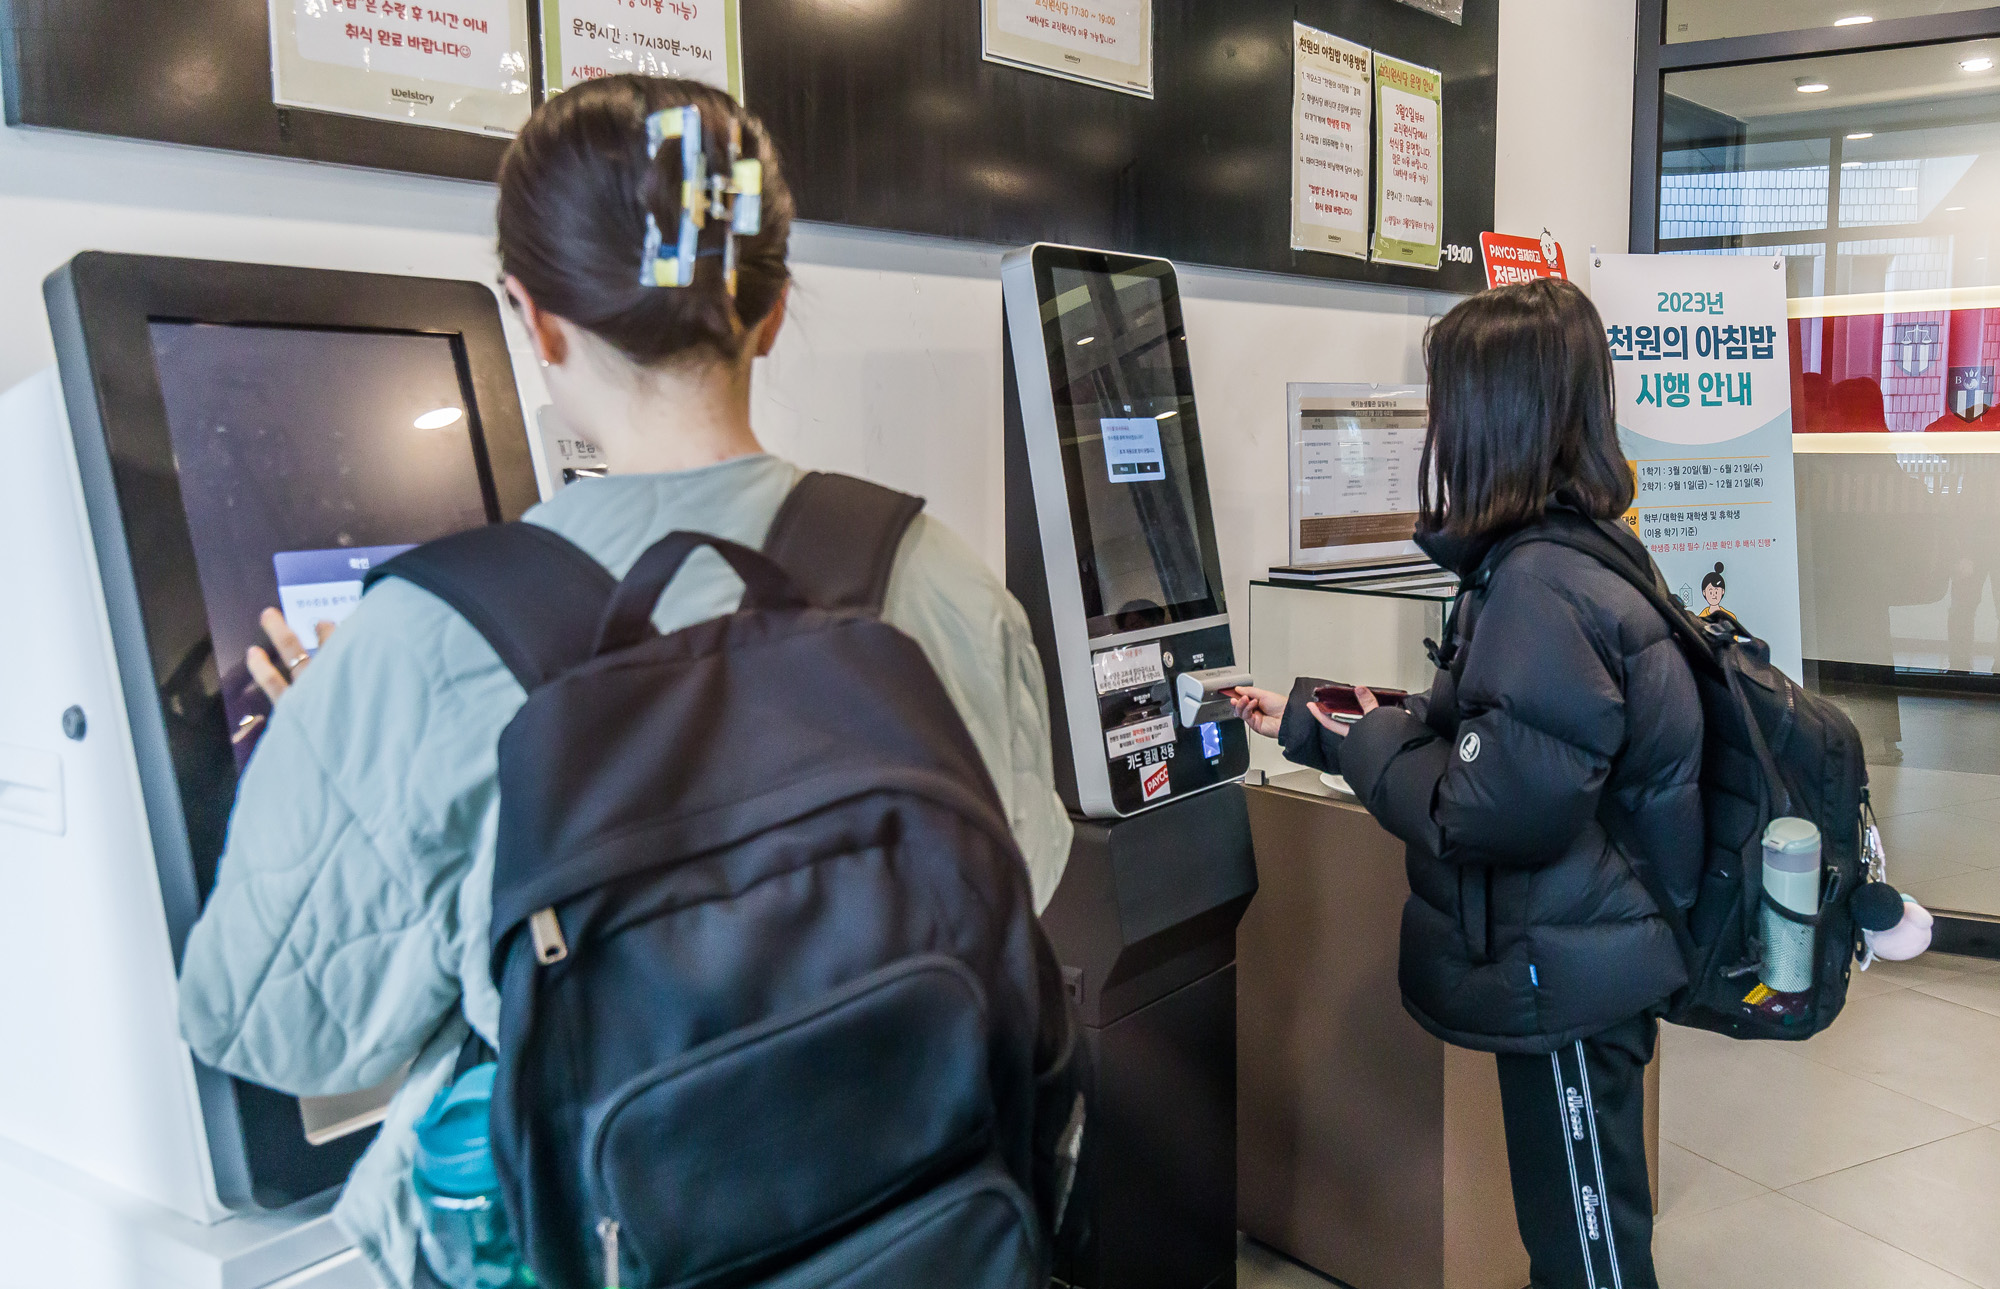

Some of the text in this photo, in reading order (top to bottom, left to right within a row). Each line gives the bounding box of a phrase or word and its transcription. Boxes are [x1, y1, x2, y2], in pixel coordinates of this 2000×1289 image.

[382, 1, 407, 20] 수령
[412, 6, 422, 21] 후
[428, 10, 459, 29] 1시간
[463, 18, 488, 33] 이내
[669, 2, 697, 20] 가능)
[1071, 5, 1089, 18] 17:30
[1098, 13, 1116, 26] 19:00
[345, 24, 373, 43] 취식
[377, 30, 403, 48] 완료
[573, 18, 621, 44] 운영시간
[632, 32, 712, 61] 17시30분~19시
[1051, 21, 1077, 36] 교직원식당
[1078, 28, 1088, 39] 이용
[1300, 37, 1367, 72] 천원의 아침밥 이용방법
[1306, 72, 1322, 84] 키오스크
[1379, 64, 1434, 93] 교직원식당 운영 안내
[1307, 93, 1323, 107] 학생식당
[1395, 103, 1424, 123] 3월2일부터
[1401, 156, 1410, 168] 이용
[1408, 171, 1417, 183] 이용
[1418, 174, 1429, 185] 가능)
[1386, 189, 1402, 202] 운영시간
[1489, 245, 1541, 263] PAYCO 결제하고
[1657, 291, 1724, 315] 2023년
[1606, 324, 1777, 361] 천원의 아침밥
[1635, 371, 1752, 408] 시행 안내
[1642, 466, 1662, 476] 1학기
[1668, 465, 1681, 476] 3월
[1682, 464, 1712, 475] 20일(월)
[1720, 464, 1732, 474] 6월
[1733, 462, 1764, 474] 21일(수)
[1642, 481, 1663, 492] 2학기
[1668, 480, 1681, 491] 9월
[1683, 479, 1708, 490] 1일(금)
[1716, 479, 1733, 489] 12월
[1734, 477, 1764, 488] 21일(목)
[1644, 509, 1741, 524] 학부/대학원 재학생 및 휴학생
[1644, 526, 1698, 539] (이용 학기 기준)
[1650, 543, 1671, 553] 학생증
[1687, 541, 1701, 552] 필수
[1720, 539, 1733, 550] 확인
[1735, 539, 1741, 549] 후
[1742, 538, 1756, 548] 배식
[1757, 538, 1771, 548] 진행
[1127, 743, 1175, 770] 카드 결제 전용
[1147, 768, 1168, 793] PAYCO
[1565, 1086, 1584, 1141] ellesse
[1581, 1185, 1600, 1241] ellesse
